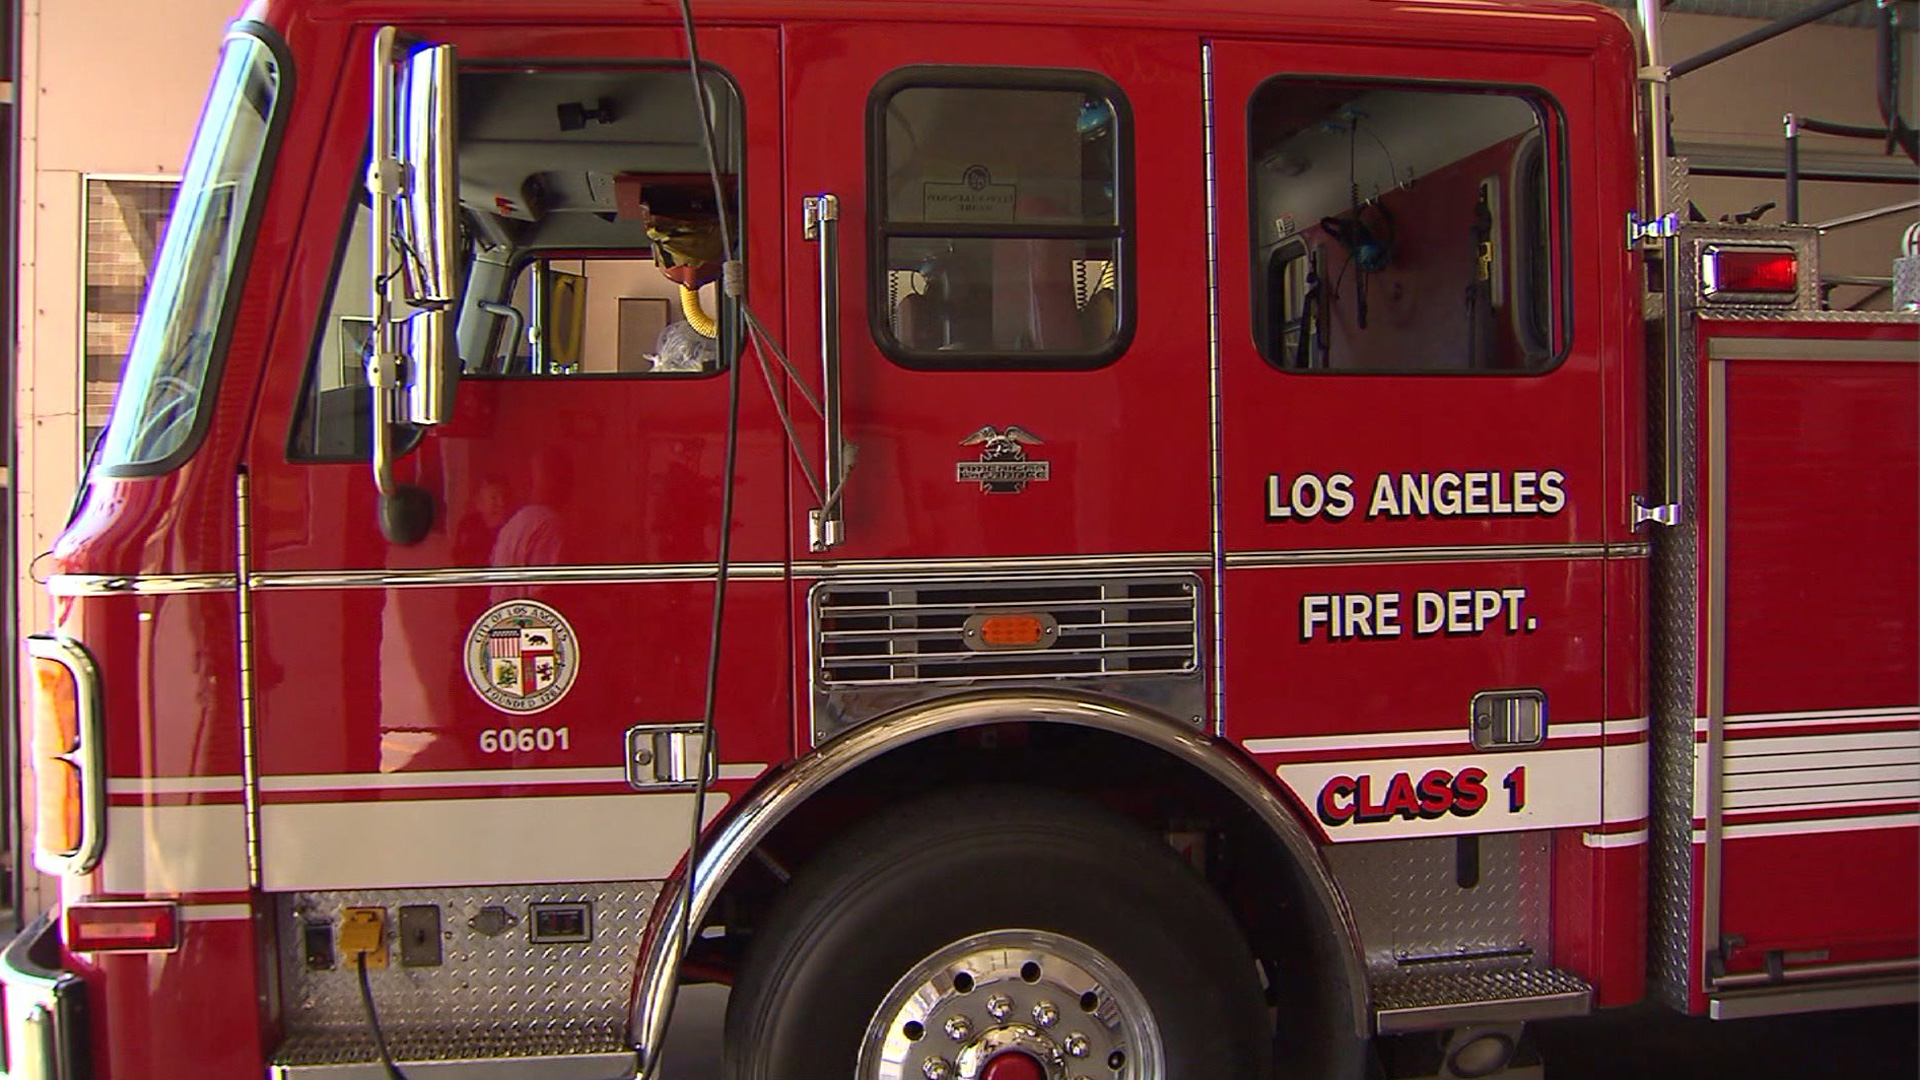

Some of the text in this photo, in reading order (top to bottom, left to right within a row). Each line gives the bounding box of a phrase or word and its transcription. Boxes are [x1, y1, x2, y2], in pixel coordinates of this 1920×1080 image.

[1267, 470, 1566, 519] LOS ANGELES
[475, 606, 567, 643] CITY OF LOS ANGELES
[1302, 588, 1538, 640] FIRE DEPT.
[485, 684, 561, 708] FOUNDED 1781
[479, 727, 570, 753] 60601
[1318, 766, 1527, 826] CLASS 1
